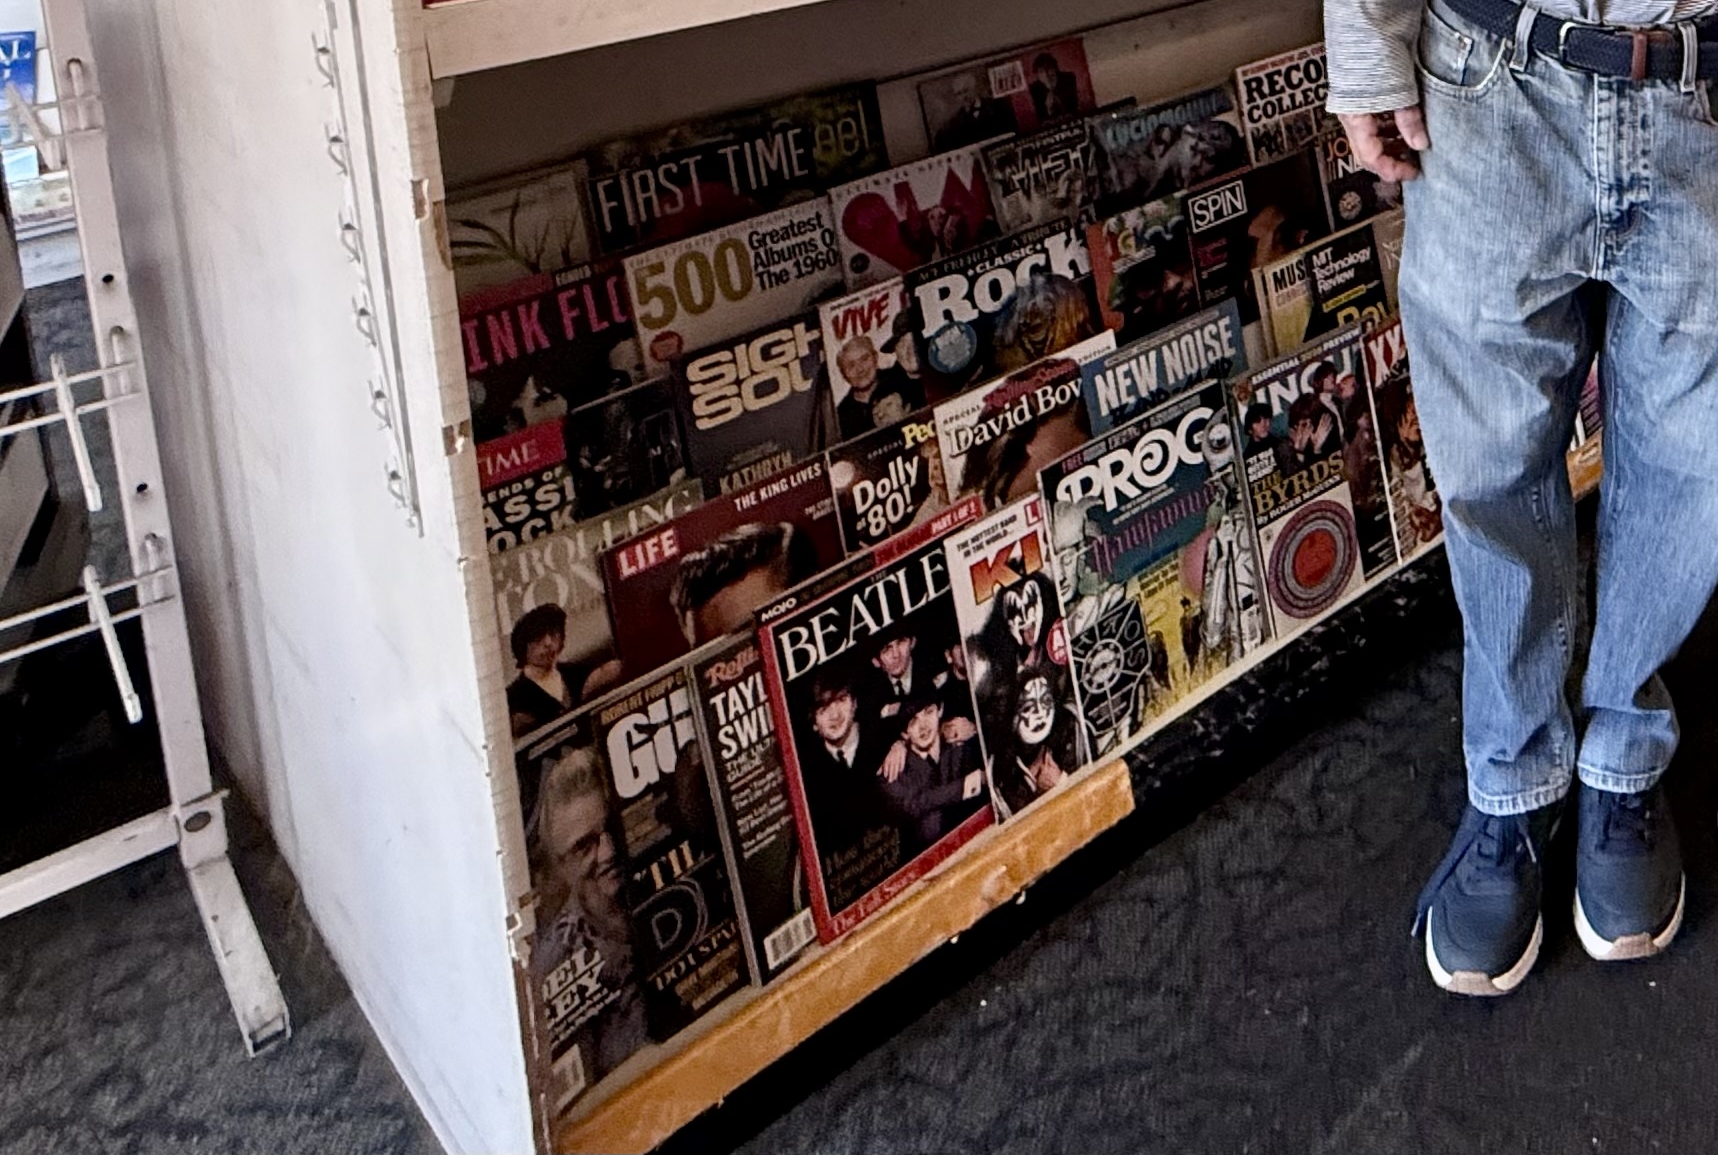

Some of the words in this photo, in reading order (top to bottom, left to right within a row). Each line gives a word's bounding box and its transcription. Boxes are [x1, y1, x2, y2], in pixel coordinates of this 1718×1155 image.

[596, 154, 704, 235] FIRST
[719, 127, 811, 197] TIME
[746, 210, 824, 251] Greatest
[1193, 187, 1244, 227] SPIN
[752, 235, 818, 272] Albums
[755, 266, 790, 291] The
[1312, 247, 1335, 266] MIT
[1312, 246, 1371, 282] Technology
[634, 237, 756, 333] 500
[1318, 267, 1356, 294] Review
[462, 289, 552, 374] INK
[832, 292, 890, 342] VIVE
[1094, 355, 1160, 418] NEW
[1162, 318, 1237, 378] NOISE
[1251, 357, 1301, 386] ESSENTIAL
[942, 404, 982, 426] SPECIAL
[948, 406, 1033, 458] David
[718, 452, 795, 495] KATHRYN
[1055, 406, 1216, 513] PROG
[1252, 470, 1282, 492] THE
[1252, 450, 1346, 515] BYRDS
[733, 494, 759, 513] THE
[759, 479, 791, 504] KING
[790, 461, 823, 489] LIVES
[851, 454, 919, 516] Dolly
[855, 518, 868, 532] at
[866, 485, 916, 538] 80!
[970, 525, 998, 545] HOTTEST
[617, 528, 681, 582] LIFE
[969, 530, 1045, 605] KI
[759, 596, 798, 623] MOJO
[779, 548, 951, 683] BEATLE
